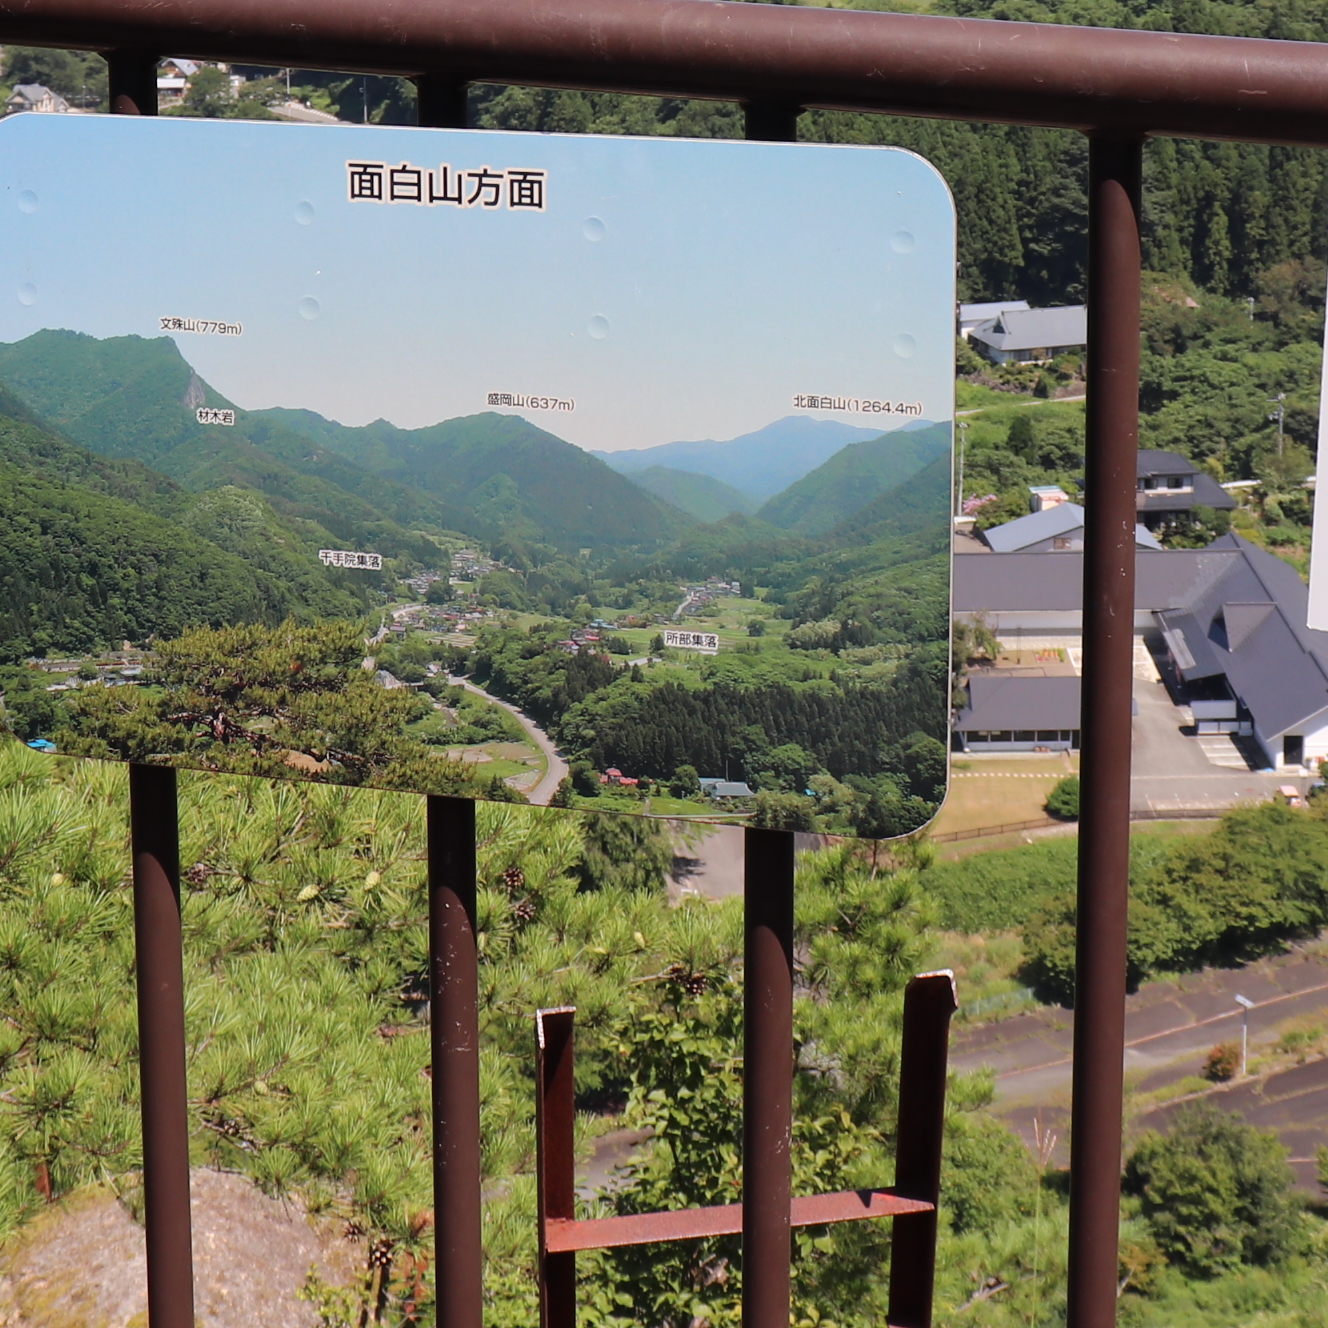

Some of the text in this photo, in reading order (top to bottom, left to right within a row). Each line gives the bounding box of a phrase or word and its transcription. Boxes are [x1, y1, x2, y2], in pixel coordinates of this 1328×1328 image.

[348, 162, 545, 209] 面白山方面
[160, 317, 243, 335] 文殊山(779m)
[487, 393, 575, 411] 盛岡山(637m)
[793, 394, 922, 415] 北面白山(1264.4m)
[198, 409, 233, 424] 材木岩
[320, 551, 380, 568] 千手院集落
[665, 632, 717, 648] 所部集落
